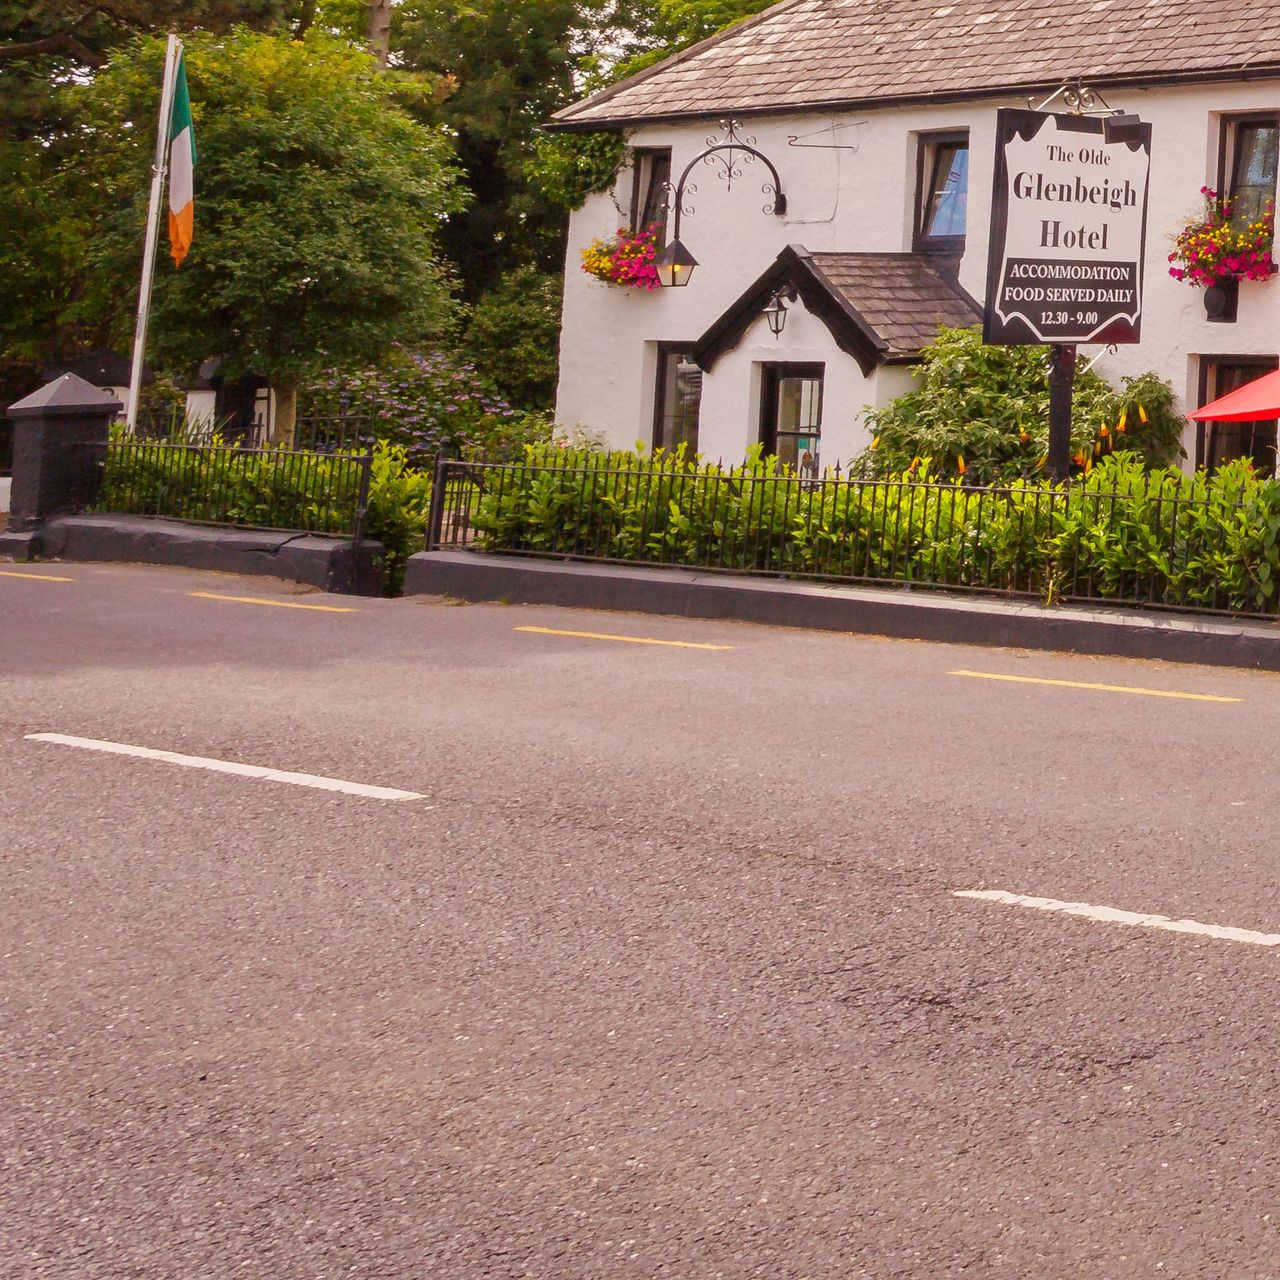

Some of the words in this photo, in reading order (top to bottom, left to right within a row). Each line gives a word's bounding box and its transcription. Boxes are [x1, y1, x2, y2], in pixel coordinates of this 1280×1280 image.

[1046, 144, 1074, 163] The
[1078, 147, 1111, 166] Olde
[1013, 171, 1137, 214] Glenbeigh
[1039, 219, 1108, 250] Hotel
[1009, 263, 1130, 281] ACCOMMODATION
[1004, 286, 1045, 302] FOOD
[1046, 287, 1096, 302] SERVED
[1097, 288, 1134, 303] DAILY
[1040, 311, 1069, 325] 12.30
[1076, 311, 1098, 325] 9.00
